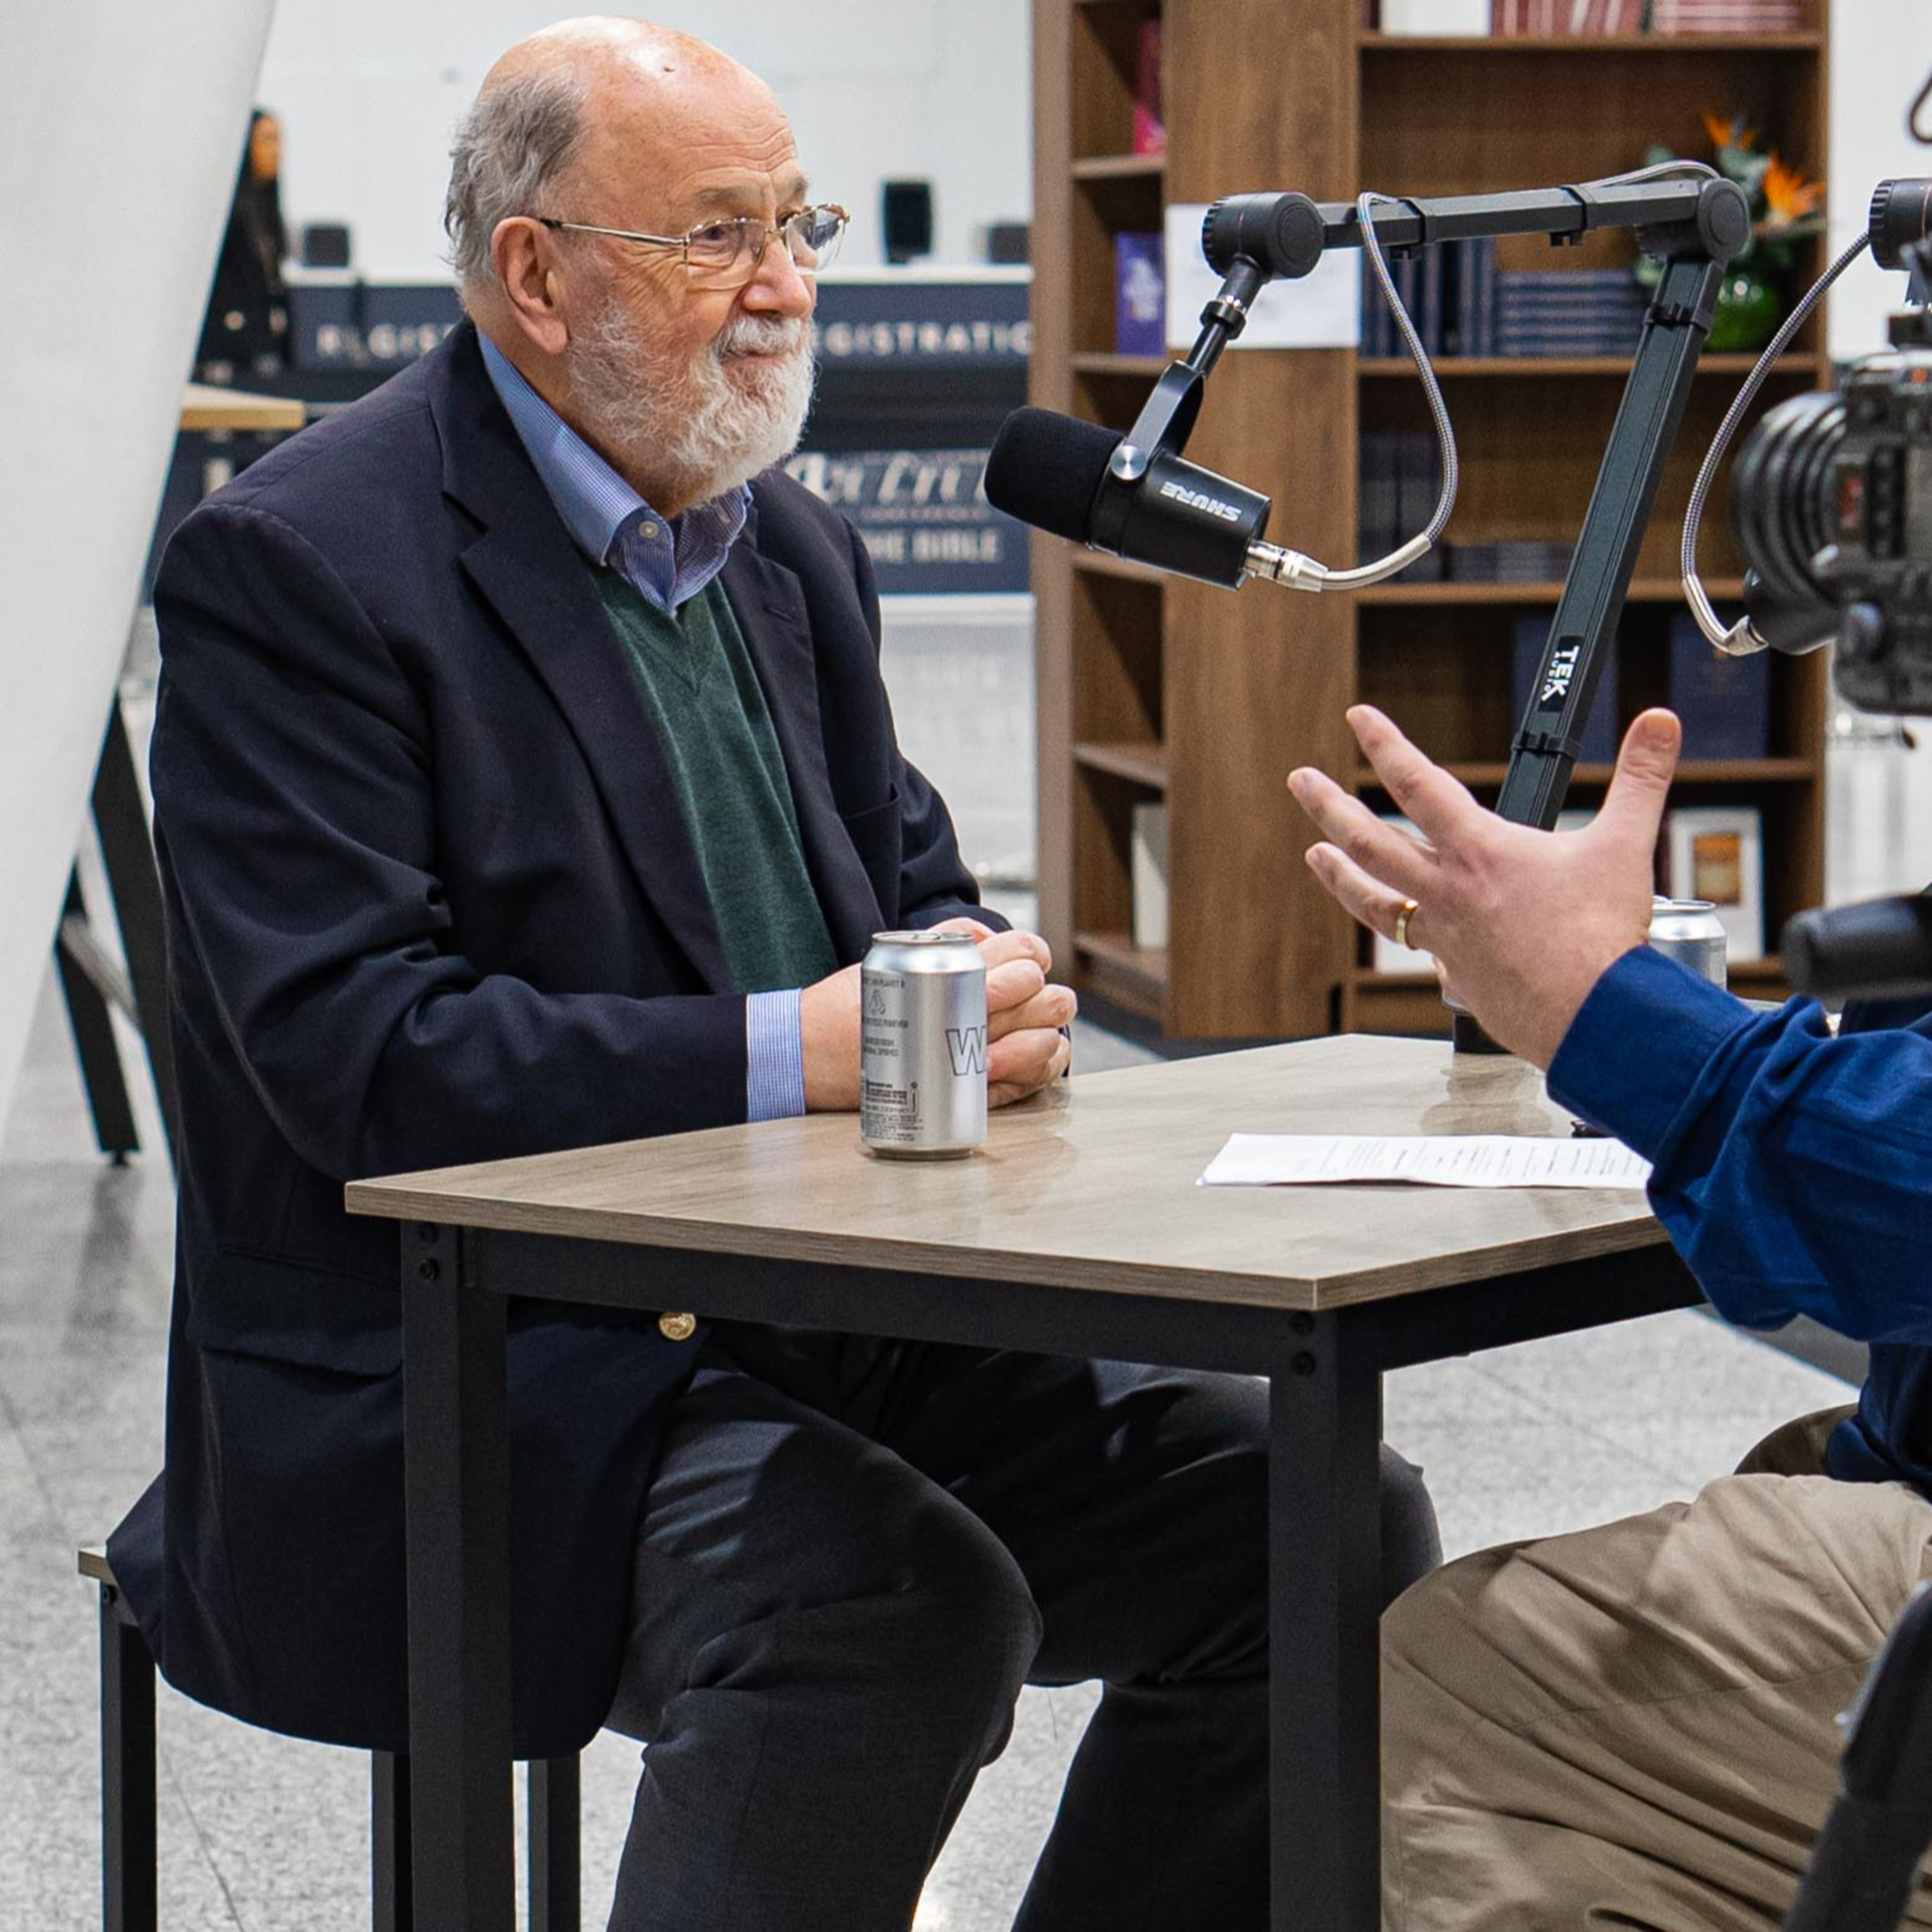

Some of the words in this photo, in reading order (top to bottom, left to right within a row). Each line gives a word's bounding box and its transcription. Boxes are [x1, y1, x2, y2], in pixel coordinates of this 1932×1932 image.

[1160, 481, 1242, 522] SHURE
[911, 528, 998, 563] BIBLE
[1541, 645, 1580, 702] TEK
